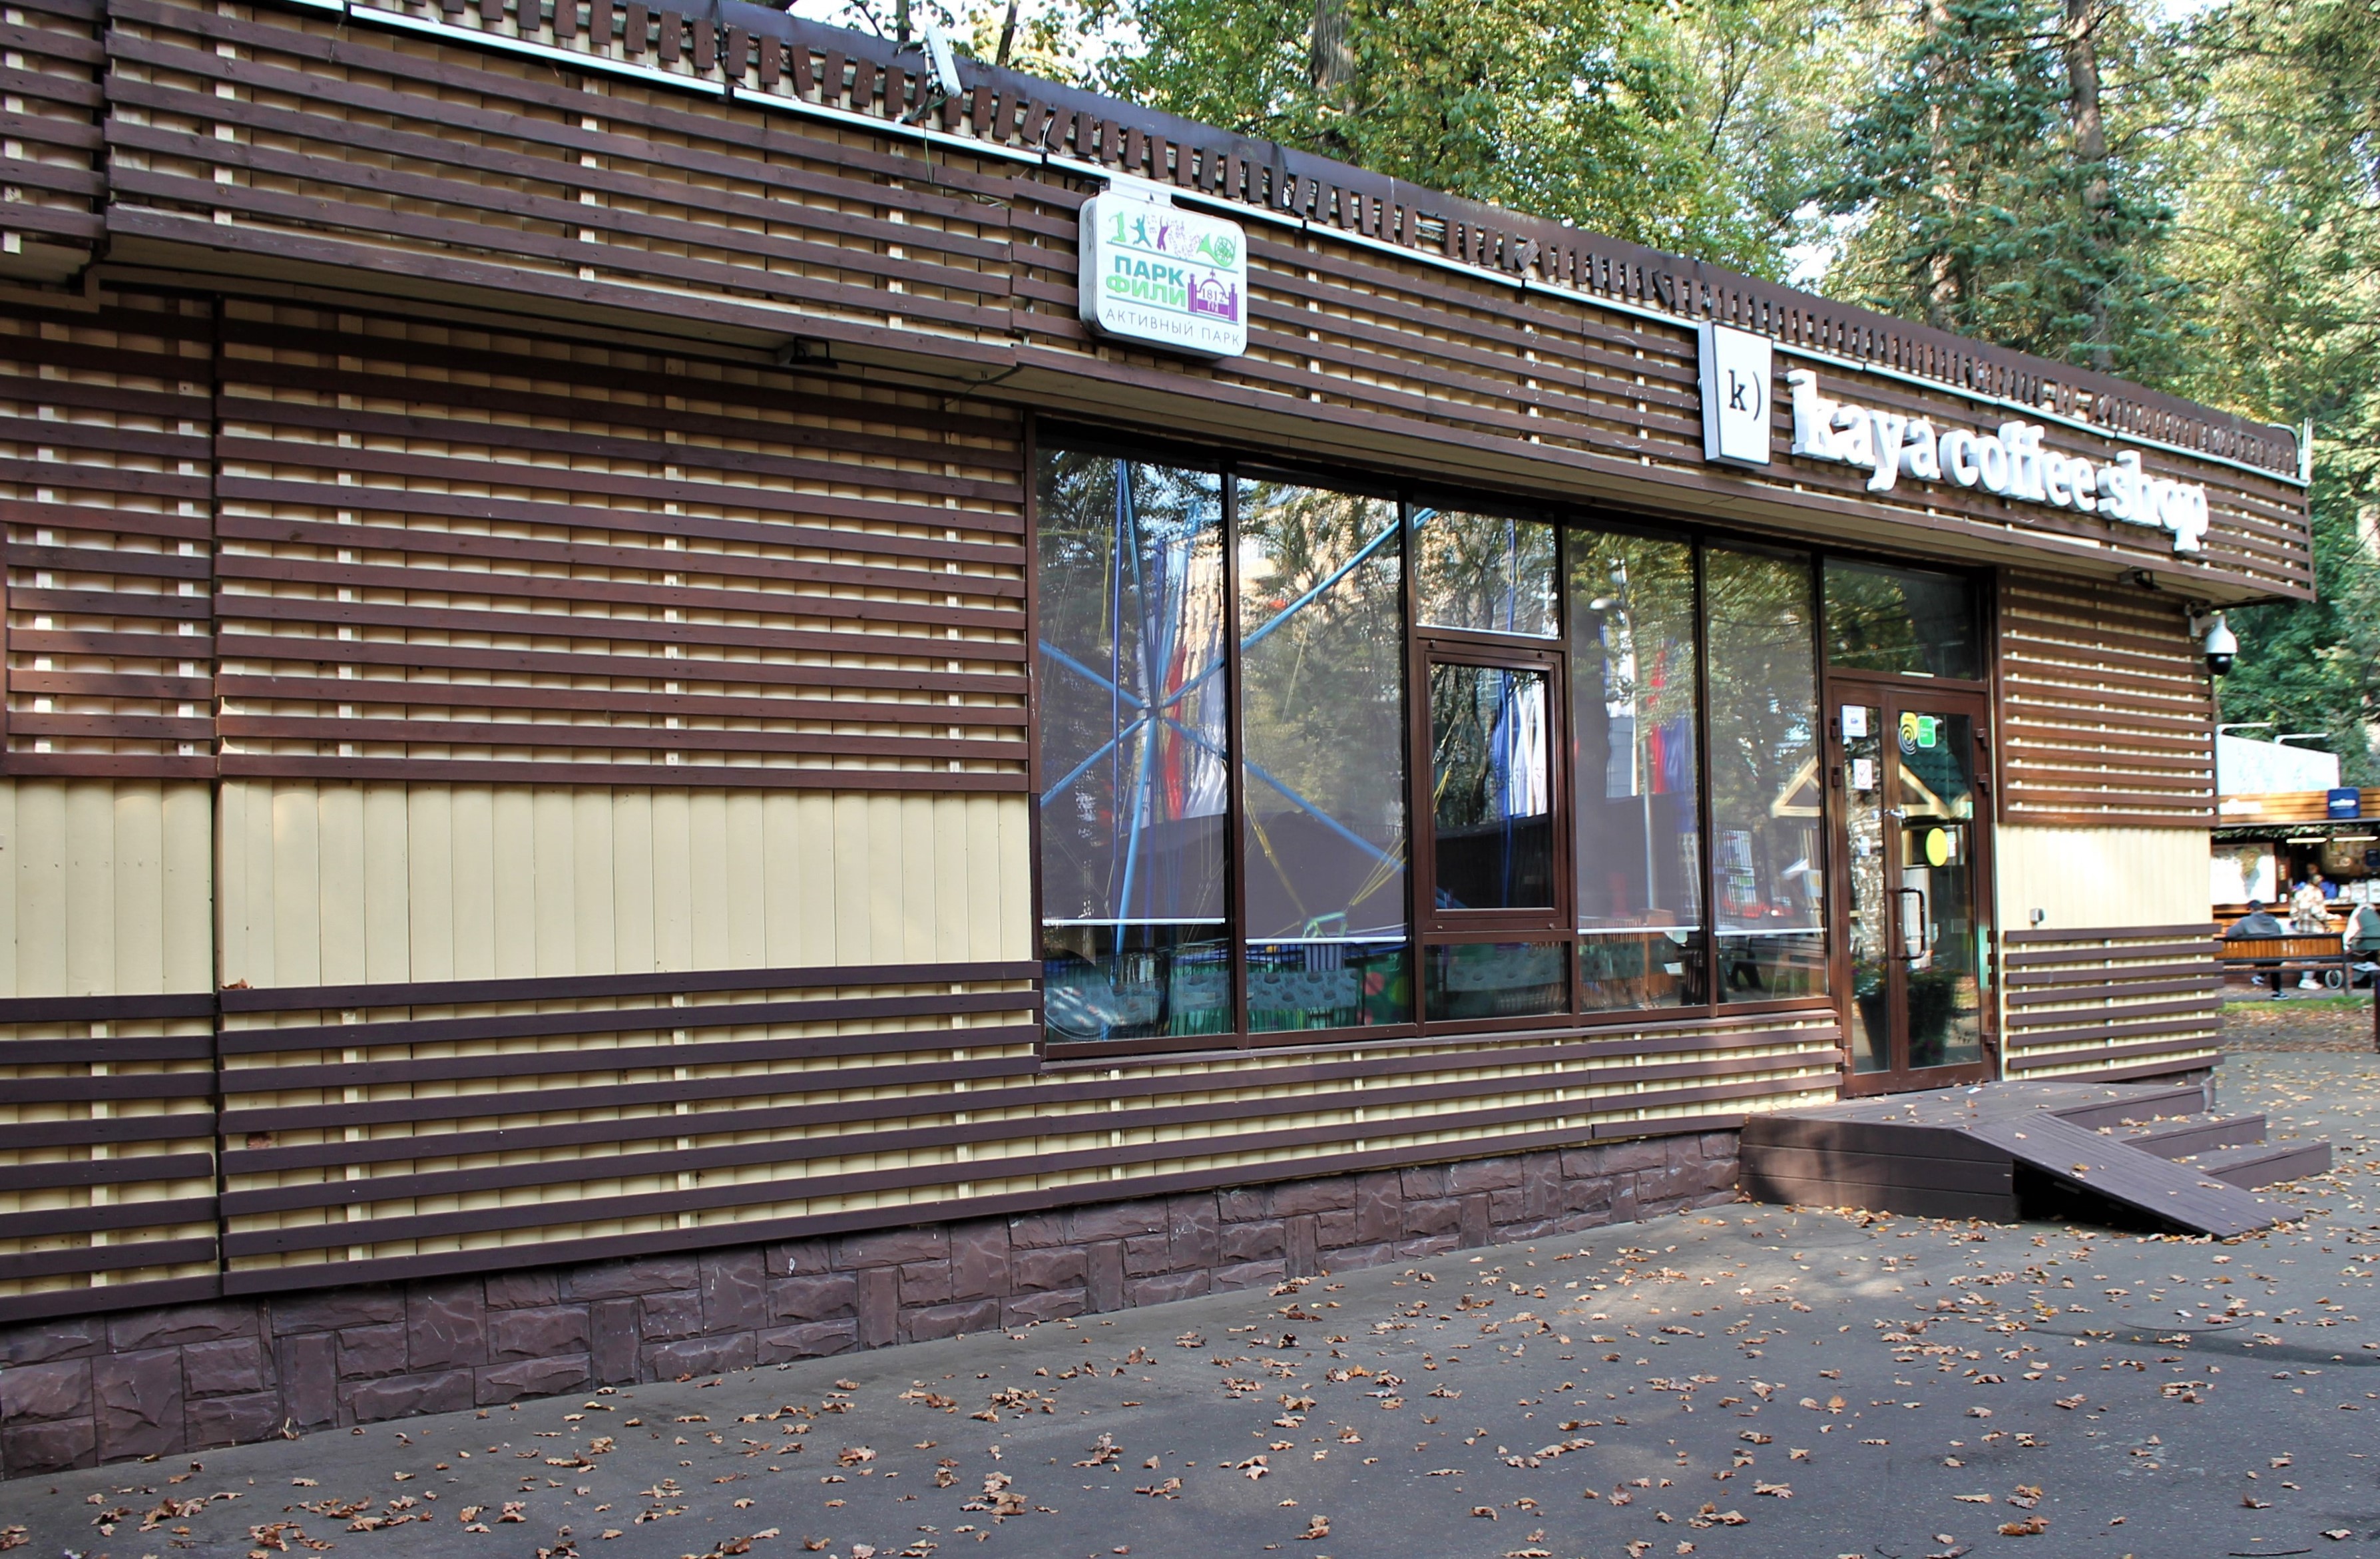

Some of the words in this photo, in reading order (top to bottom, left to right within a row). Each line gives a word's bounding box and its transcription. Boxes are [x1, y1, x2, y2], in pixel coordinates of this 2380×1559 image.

[1115, 255, 1185, 288] ПАРК
[1106, 274, 1186, 308] ФИЛИ
[1202, 288, 1225, 303] 1812
[1106, 308, 1193, 337] АКТИВНЫЙ
[1202, 327, 1240, 346] ПАРК
